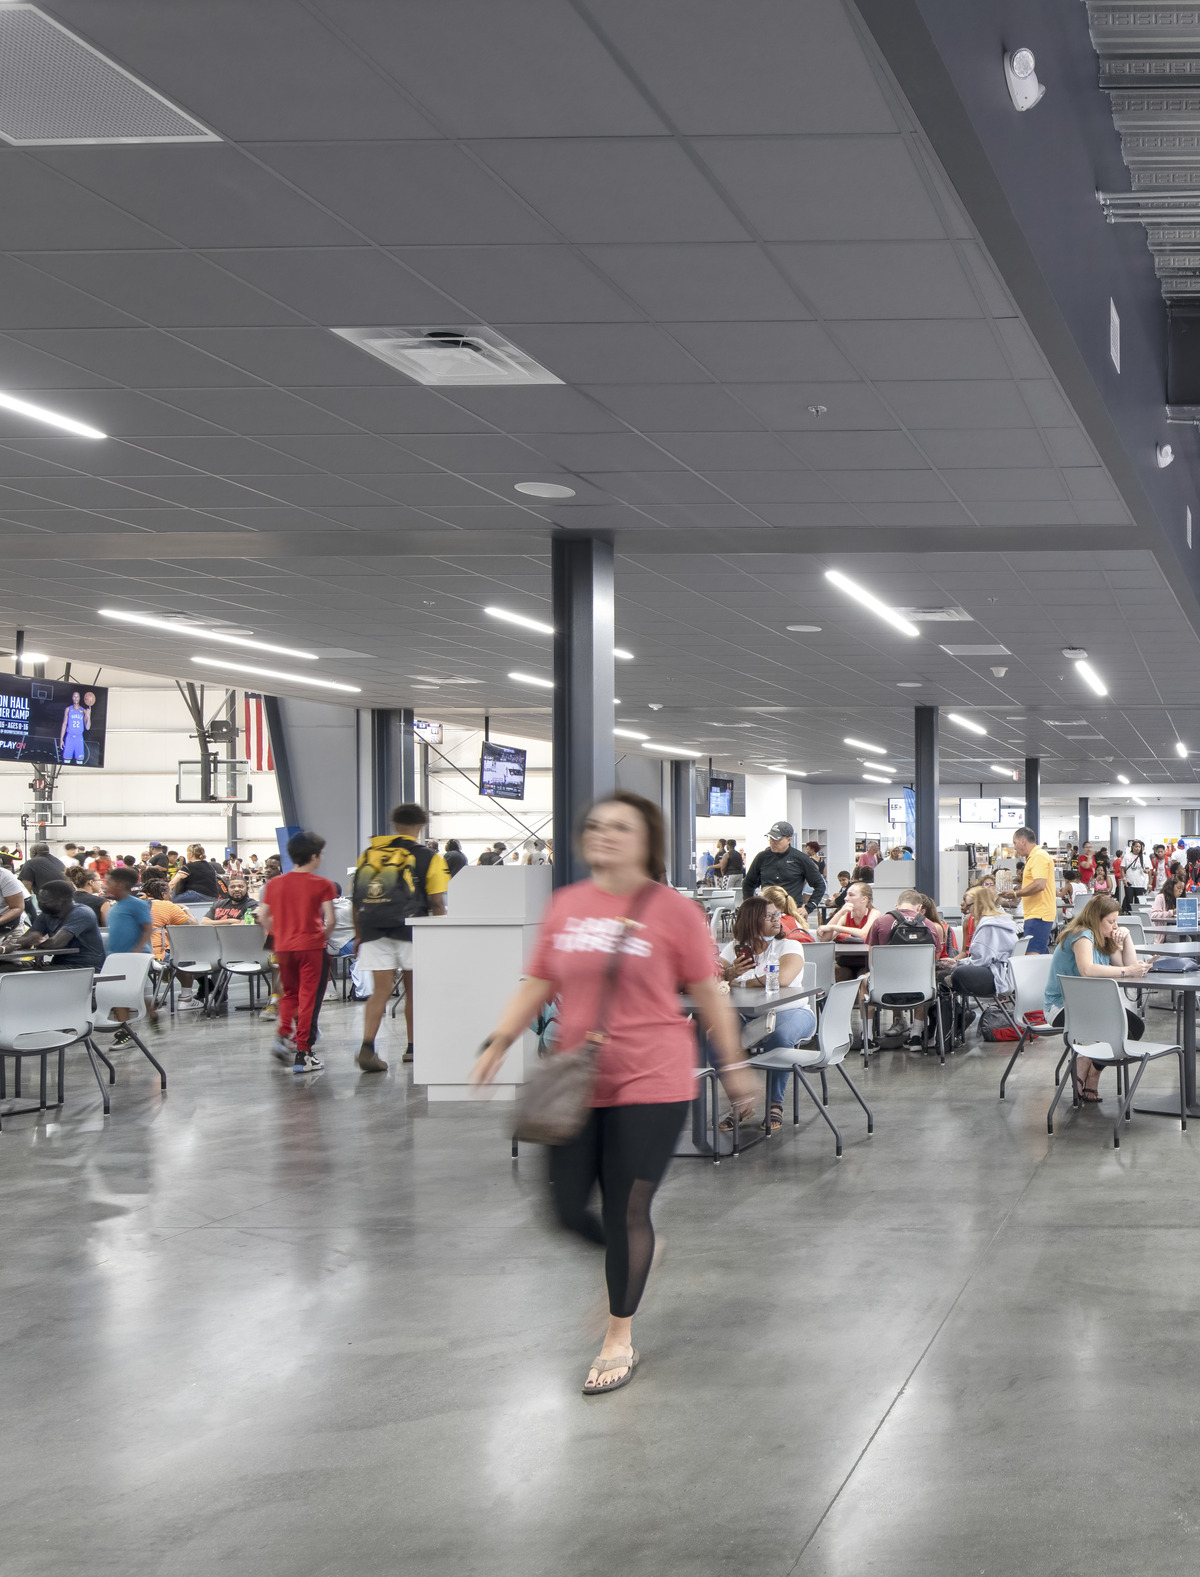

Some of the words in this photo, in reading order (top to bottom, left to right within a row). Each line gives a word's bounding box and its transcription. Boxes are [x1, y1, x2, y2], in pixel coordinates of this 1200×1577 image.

[10, 697, 30, 710] HALL
[11, 709, 30, 720] CAMP
[72, 720, 80, 728] 22
